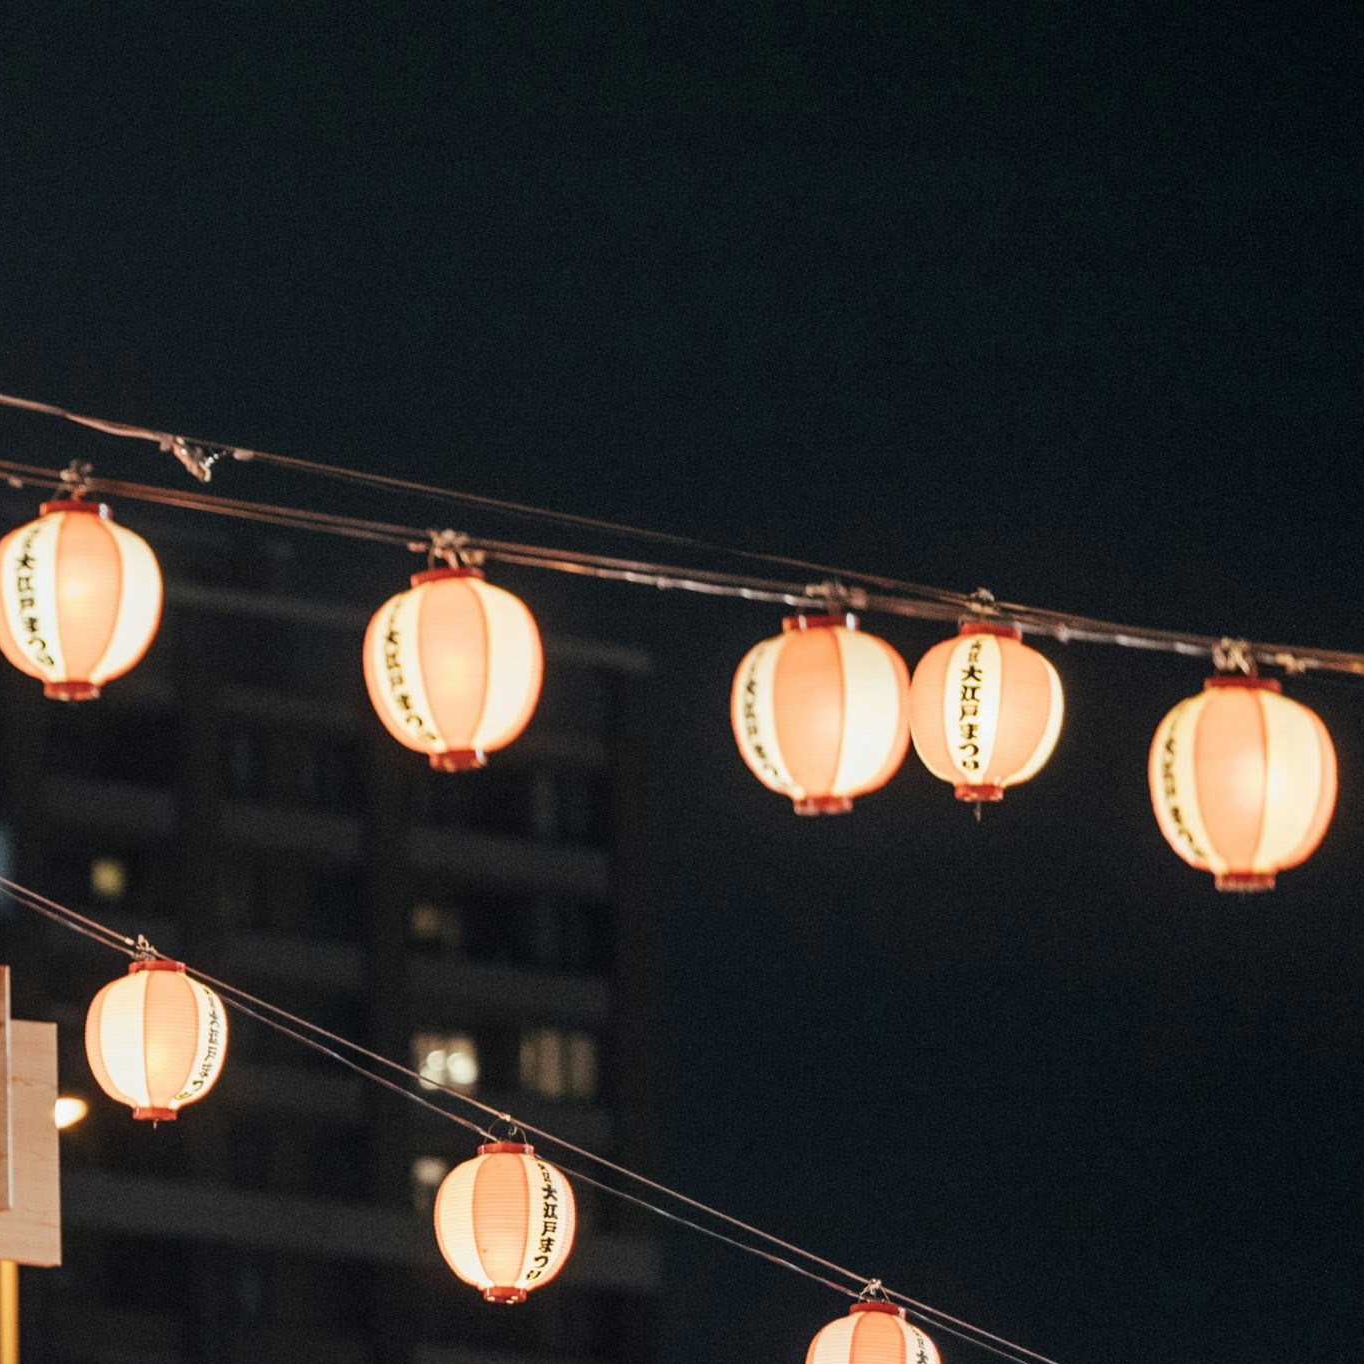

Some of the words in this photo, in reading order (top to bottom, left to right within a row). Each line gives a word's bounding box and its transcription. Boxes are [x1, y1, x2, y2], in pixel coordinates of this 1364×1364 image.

[958, 664, 983, 772] 大江戸まつり
[526, 1185, 559, 1281] 大江戸まつり
